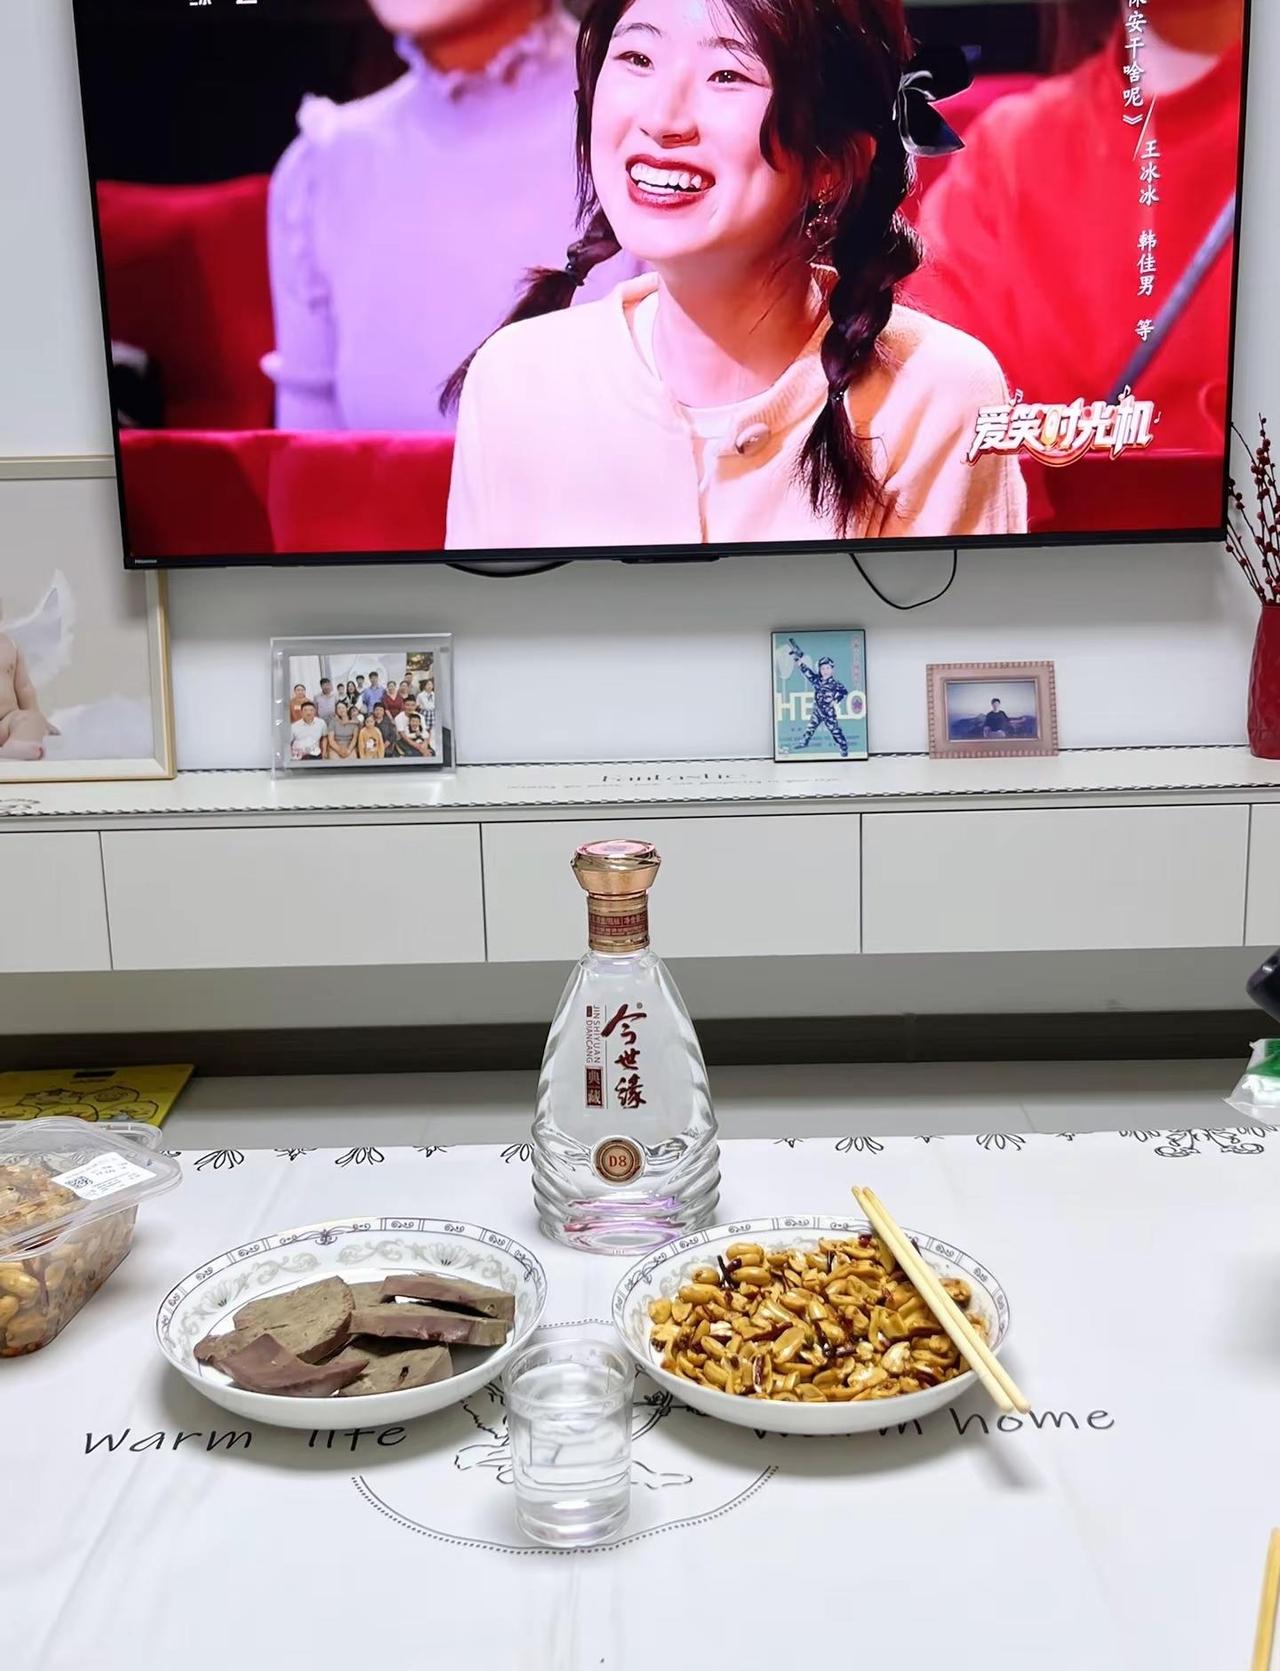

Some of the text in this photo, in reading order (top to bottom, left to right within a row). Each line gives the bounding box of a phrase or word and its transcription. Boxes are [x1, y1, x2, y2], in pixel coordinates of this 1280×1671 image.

[1134, 139, 1161, 342] 王冰冰 韩佳男 等
[968, 396, 1155, 463] 爱笑时光机
[777, 690, 867, 721] HELO
[593, 1004, 601, 1064] JINSHIYUAN
[608, 1154, 628, 1168] D8
[950, 1407, 1115, 1435] home
[84, 1428, 252, 1454] warm
